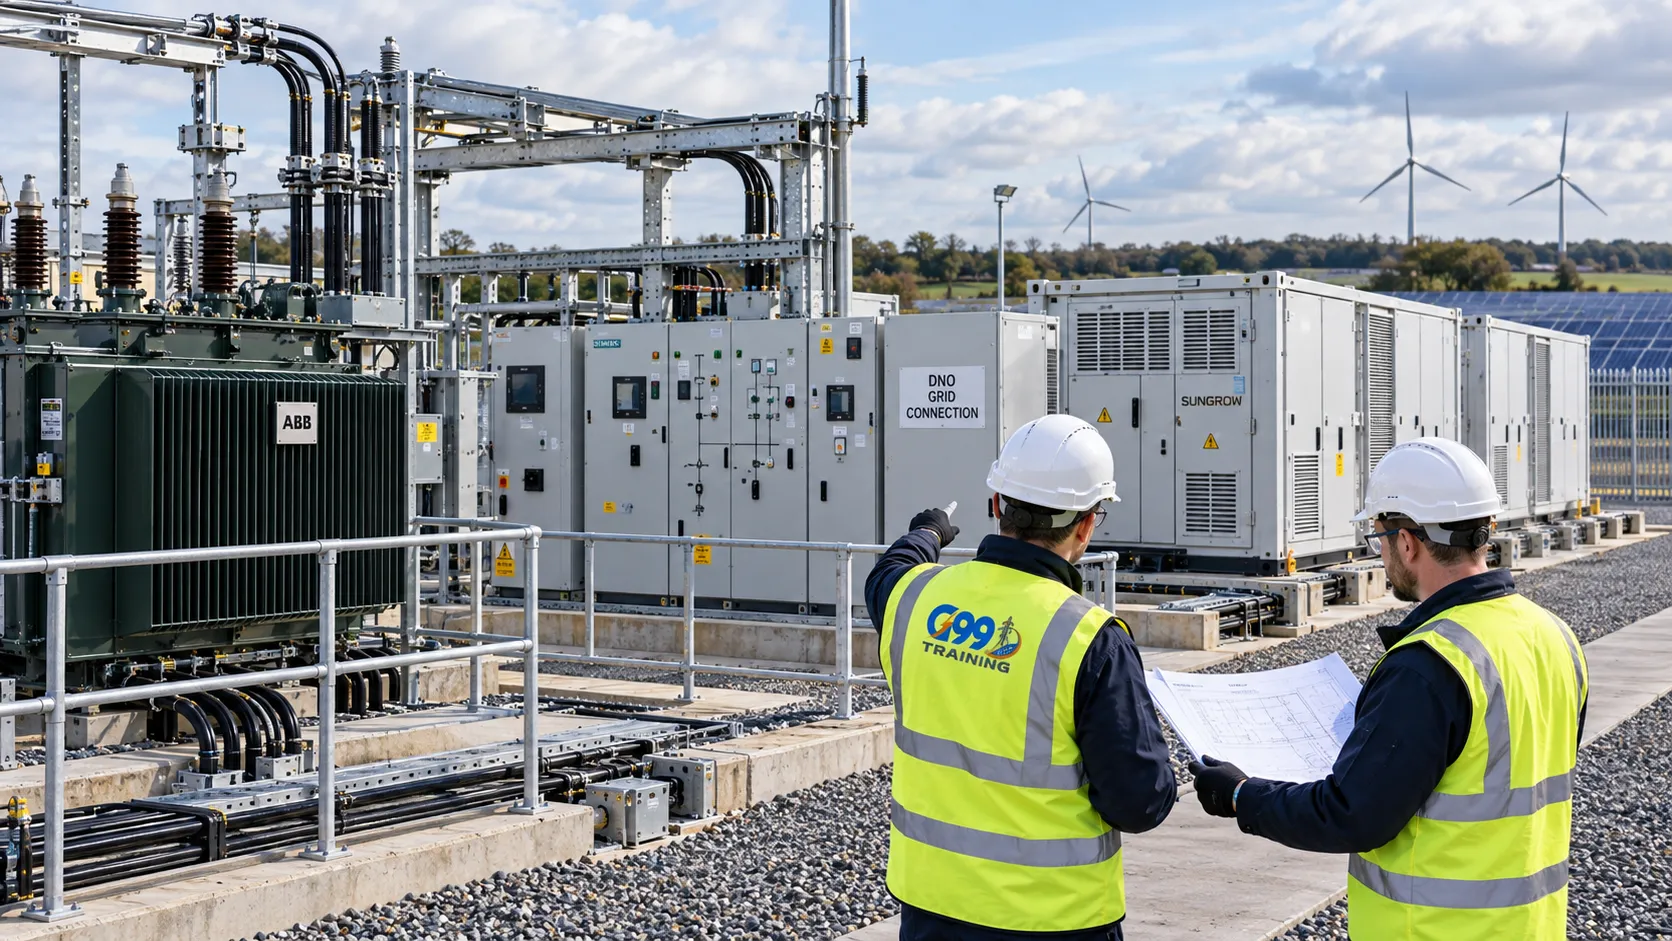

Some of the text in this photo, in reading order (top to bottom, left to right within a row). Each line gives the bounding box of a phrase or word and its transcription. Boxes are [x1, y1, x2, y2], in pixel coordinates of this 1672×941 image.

[928, 373, 956, 387] DNO
[928, 390, 956, 403] GRID
[1181, 395, 1243, 407] SUNGROW
[906, 406, 979, 419] CONNECTION
[282, 414, 312, 430] ABB
[927, 604, 996, 651] G99
[922, 641, 1011, 674] TRAINING
